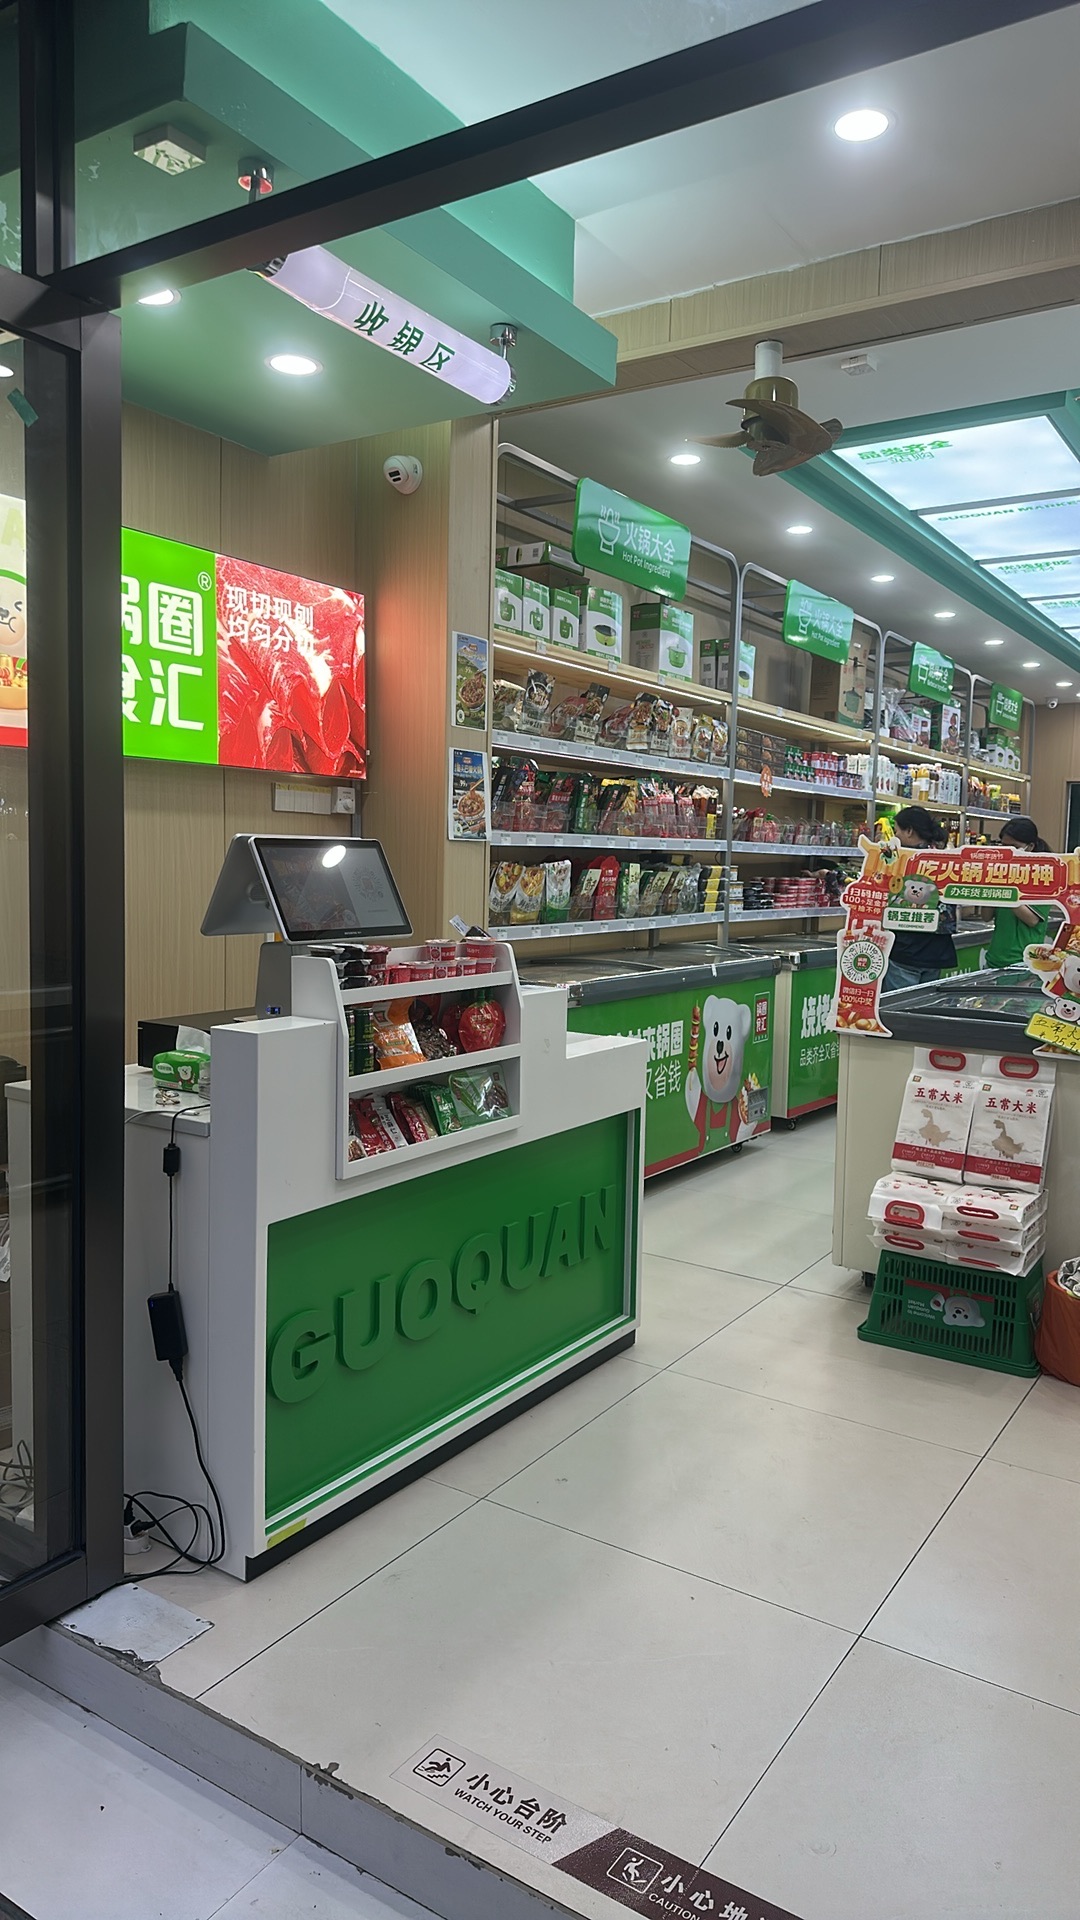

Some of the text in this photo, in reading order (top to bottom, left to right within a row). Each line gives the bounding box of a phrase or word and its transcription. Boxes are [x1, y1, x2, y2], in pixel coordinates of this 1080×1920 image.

[354, 301, 456, 374] 收银区
[858, 440, 953, 460] 品类齐全
[623, 522, 675, 566] 火锅大全
[622, 551, 671, 579] Hot Pot Ingredient
[813, 609, 844, 639] 火锅大全
[917, 860, 1054, 886] 吃火锅迎财神
[887, 910, 935, 923] 锅宝推荐
[841, 994, 873, 1007] 100%中奖
[914, 1087, 964, 1104] 五常大米
[985, 1097, 1037, 1114] 五常大米
[270, 1184, 616, 1403] GUOQUAN
[454, 1787, 553, 1845] WATCH YOUR STEP
[466, 1772, 568, 1834] 小心台阶
[660, 1874, 766, 1920] 小心地
